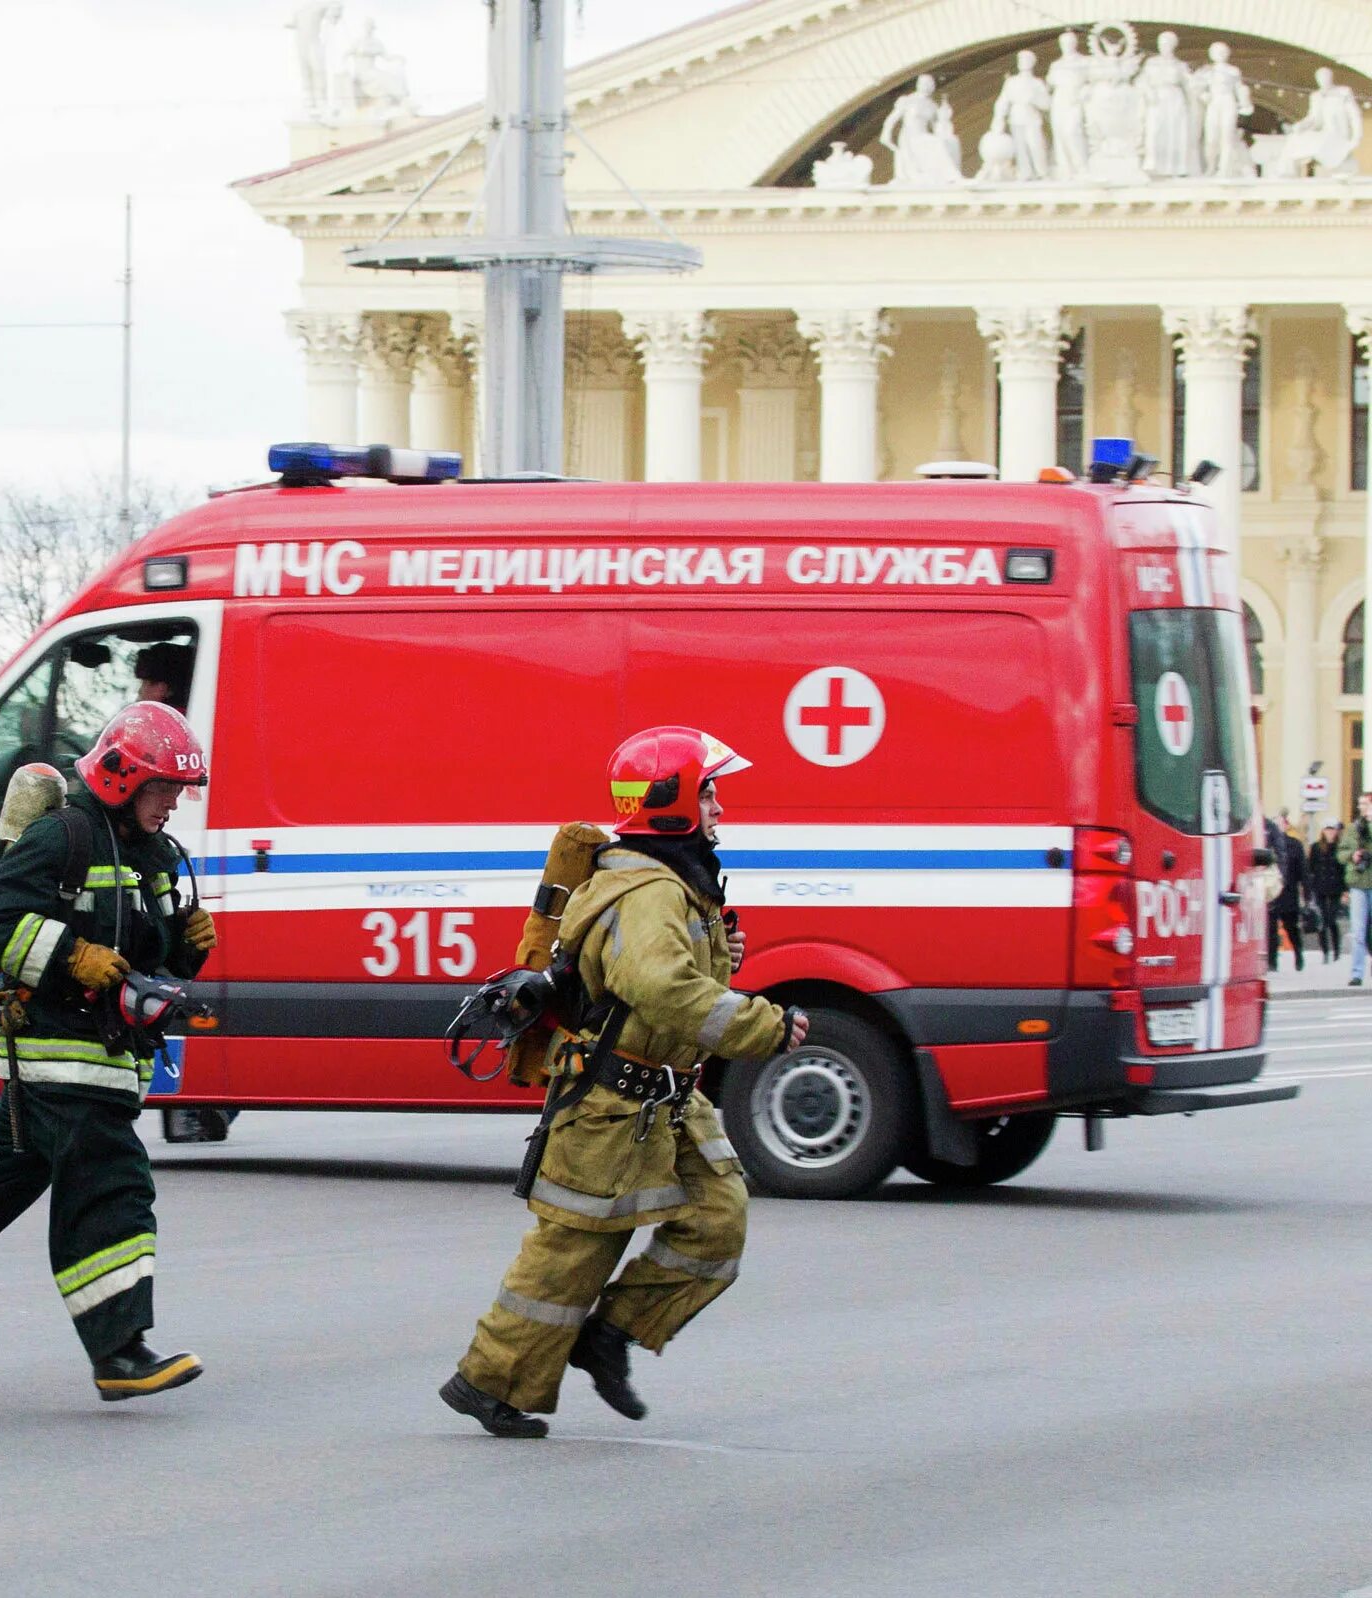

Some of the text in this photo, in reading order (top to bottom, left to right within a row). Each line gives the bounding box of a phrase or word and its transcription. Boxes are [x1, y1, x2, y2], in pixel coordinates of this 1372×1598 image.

[233, 541, 1003, 597] МЧС МЕДИЦИНСКАЯ СЛУЖБА
[366, 883, 468, 897] МИНСК
[774, 882, 854, 896] РОСН
[361, 910, 478, 977] 315
